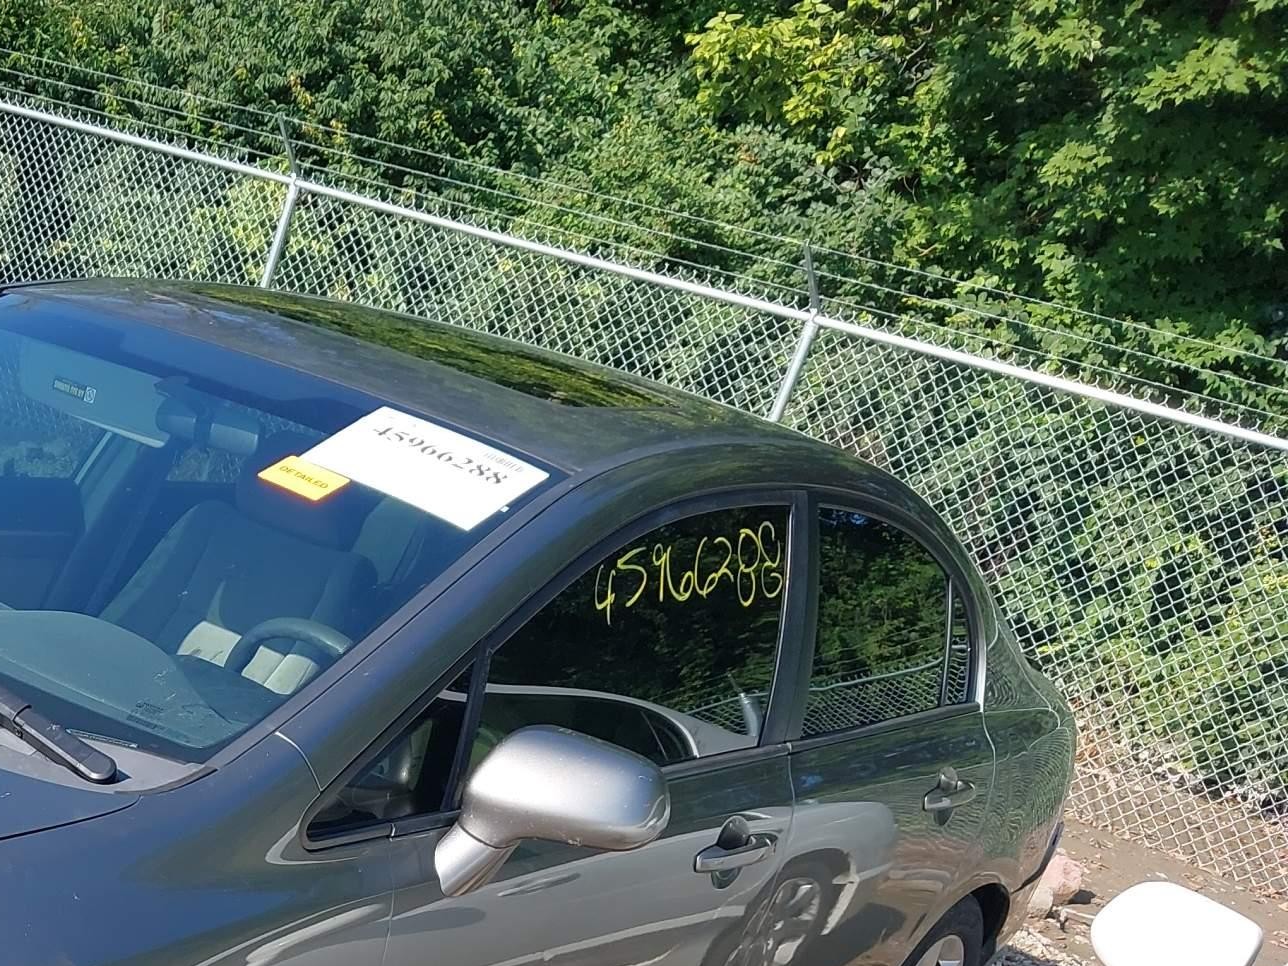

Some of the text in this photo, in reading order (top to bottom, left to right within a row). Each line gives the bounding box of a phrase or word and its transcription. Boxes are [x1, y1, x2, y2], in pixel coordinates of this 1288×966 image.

[278, 464, 330, 490] DETAILED
[372, 426, 508, 485] 45966288
[594, 520, 785, 626] 45966288
